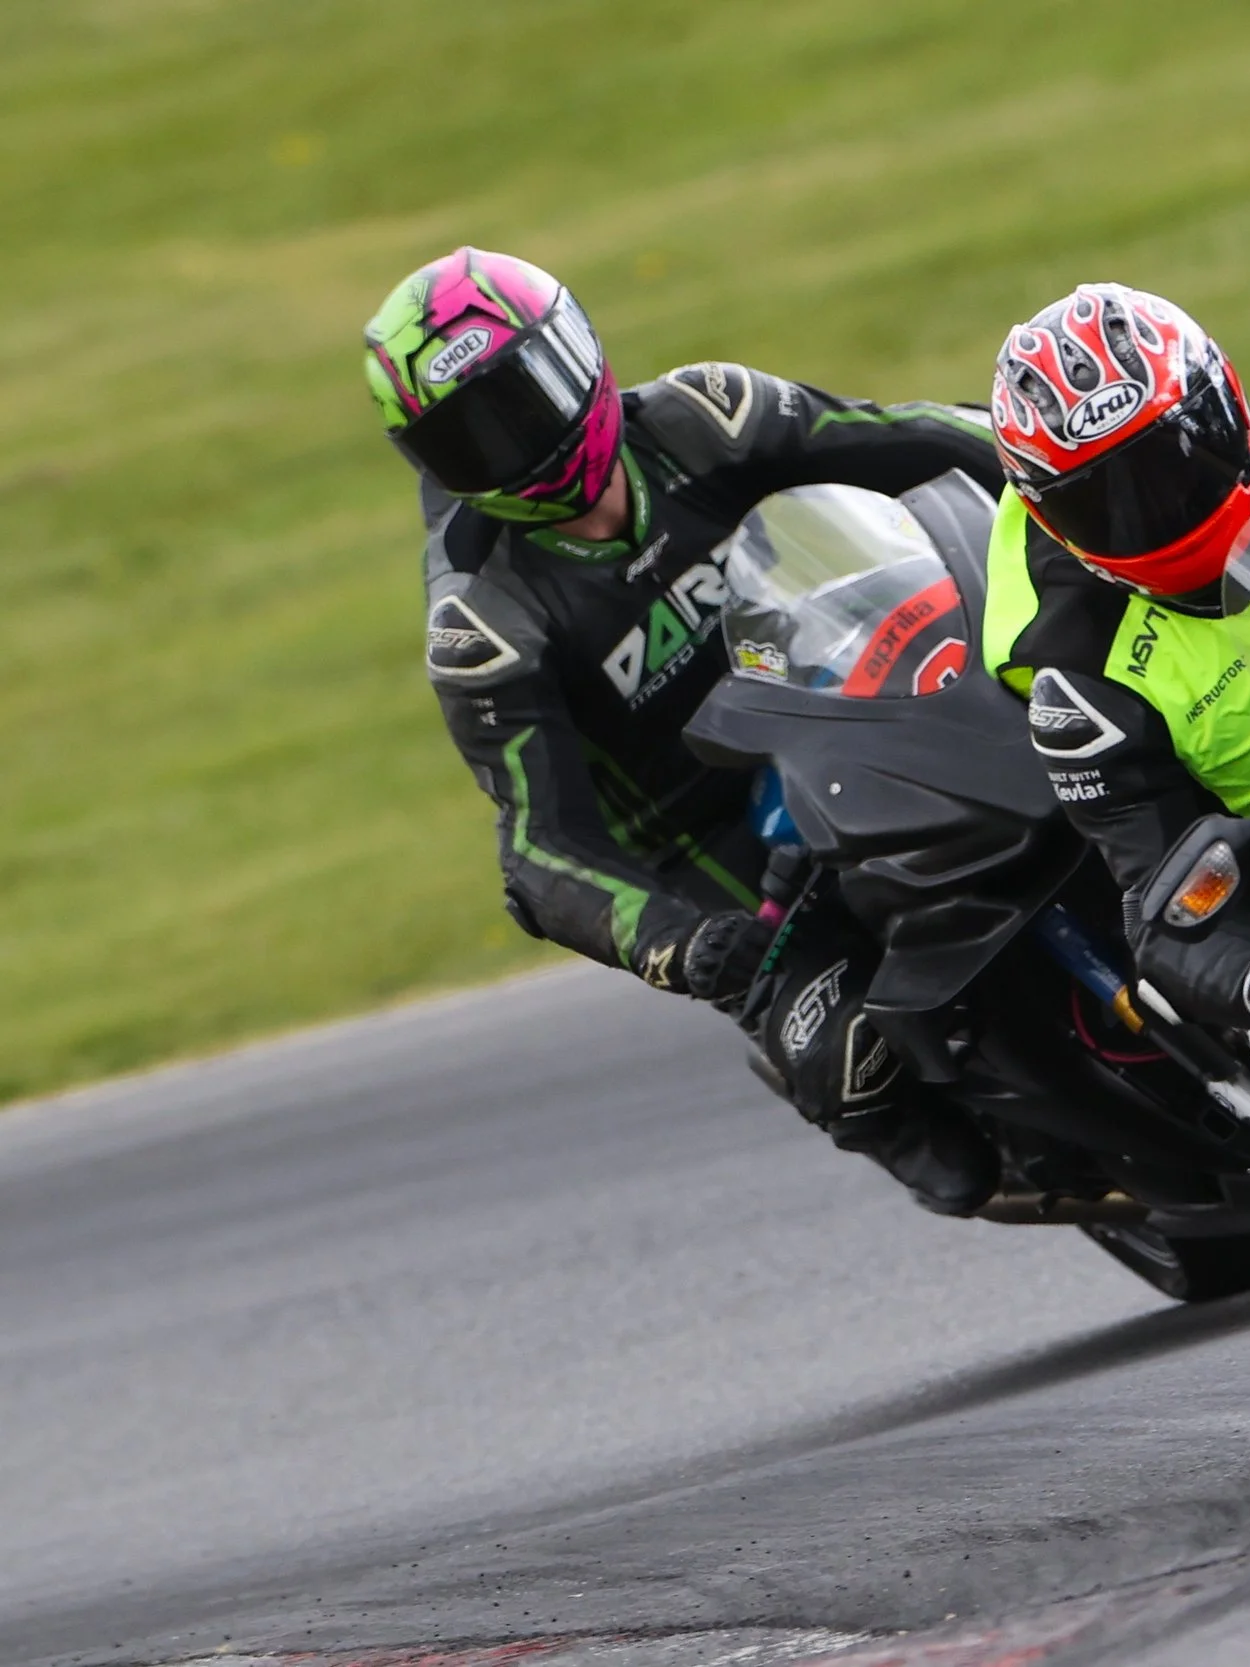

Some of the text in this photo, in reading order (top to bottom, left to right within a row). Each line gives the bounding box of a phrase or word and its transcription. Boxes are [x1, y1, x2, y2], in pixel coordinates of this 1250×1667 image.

[433, 333, 483, 378] SHOEI
[1075, 384, 1134, 437] Arai
[864, 601, 935, 680] aprilia
[1127, 606, 1168, 678] MSVT
[1186, 658, 1247, 725] INSTRUCTOR
[779, 958, 848, 1061] RST
[854, 1036, 889, 1091] RS
